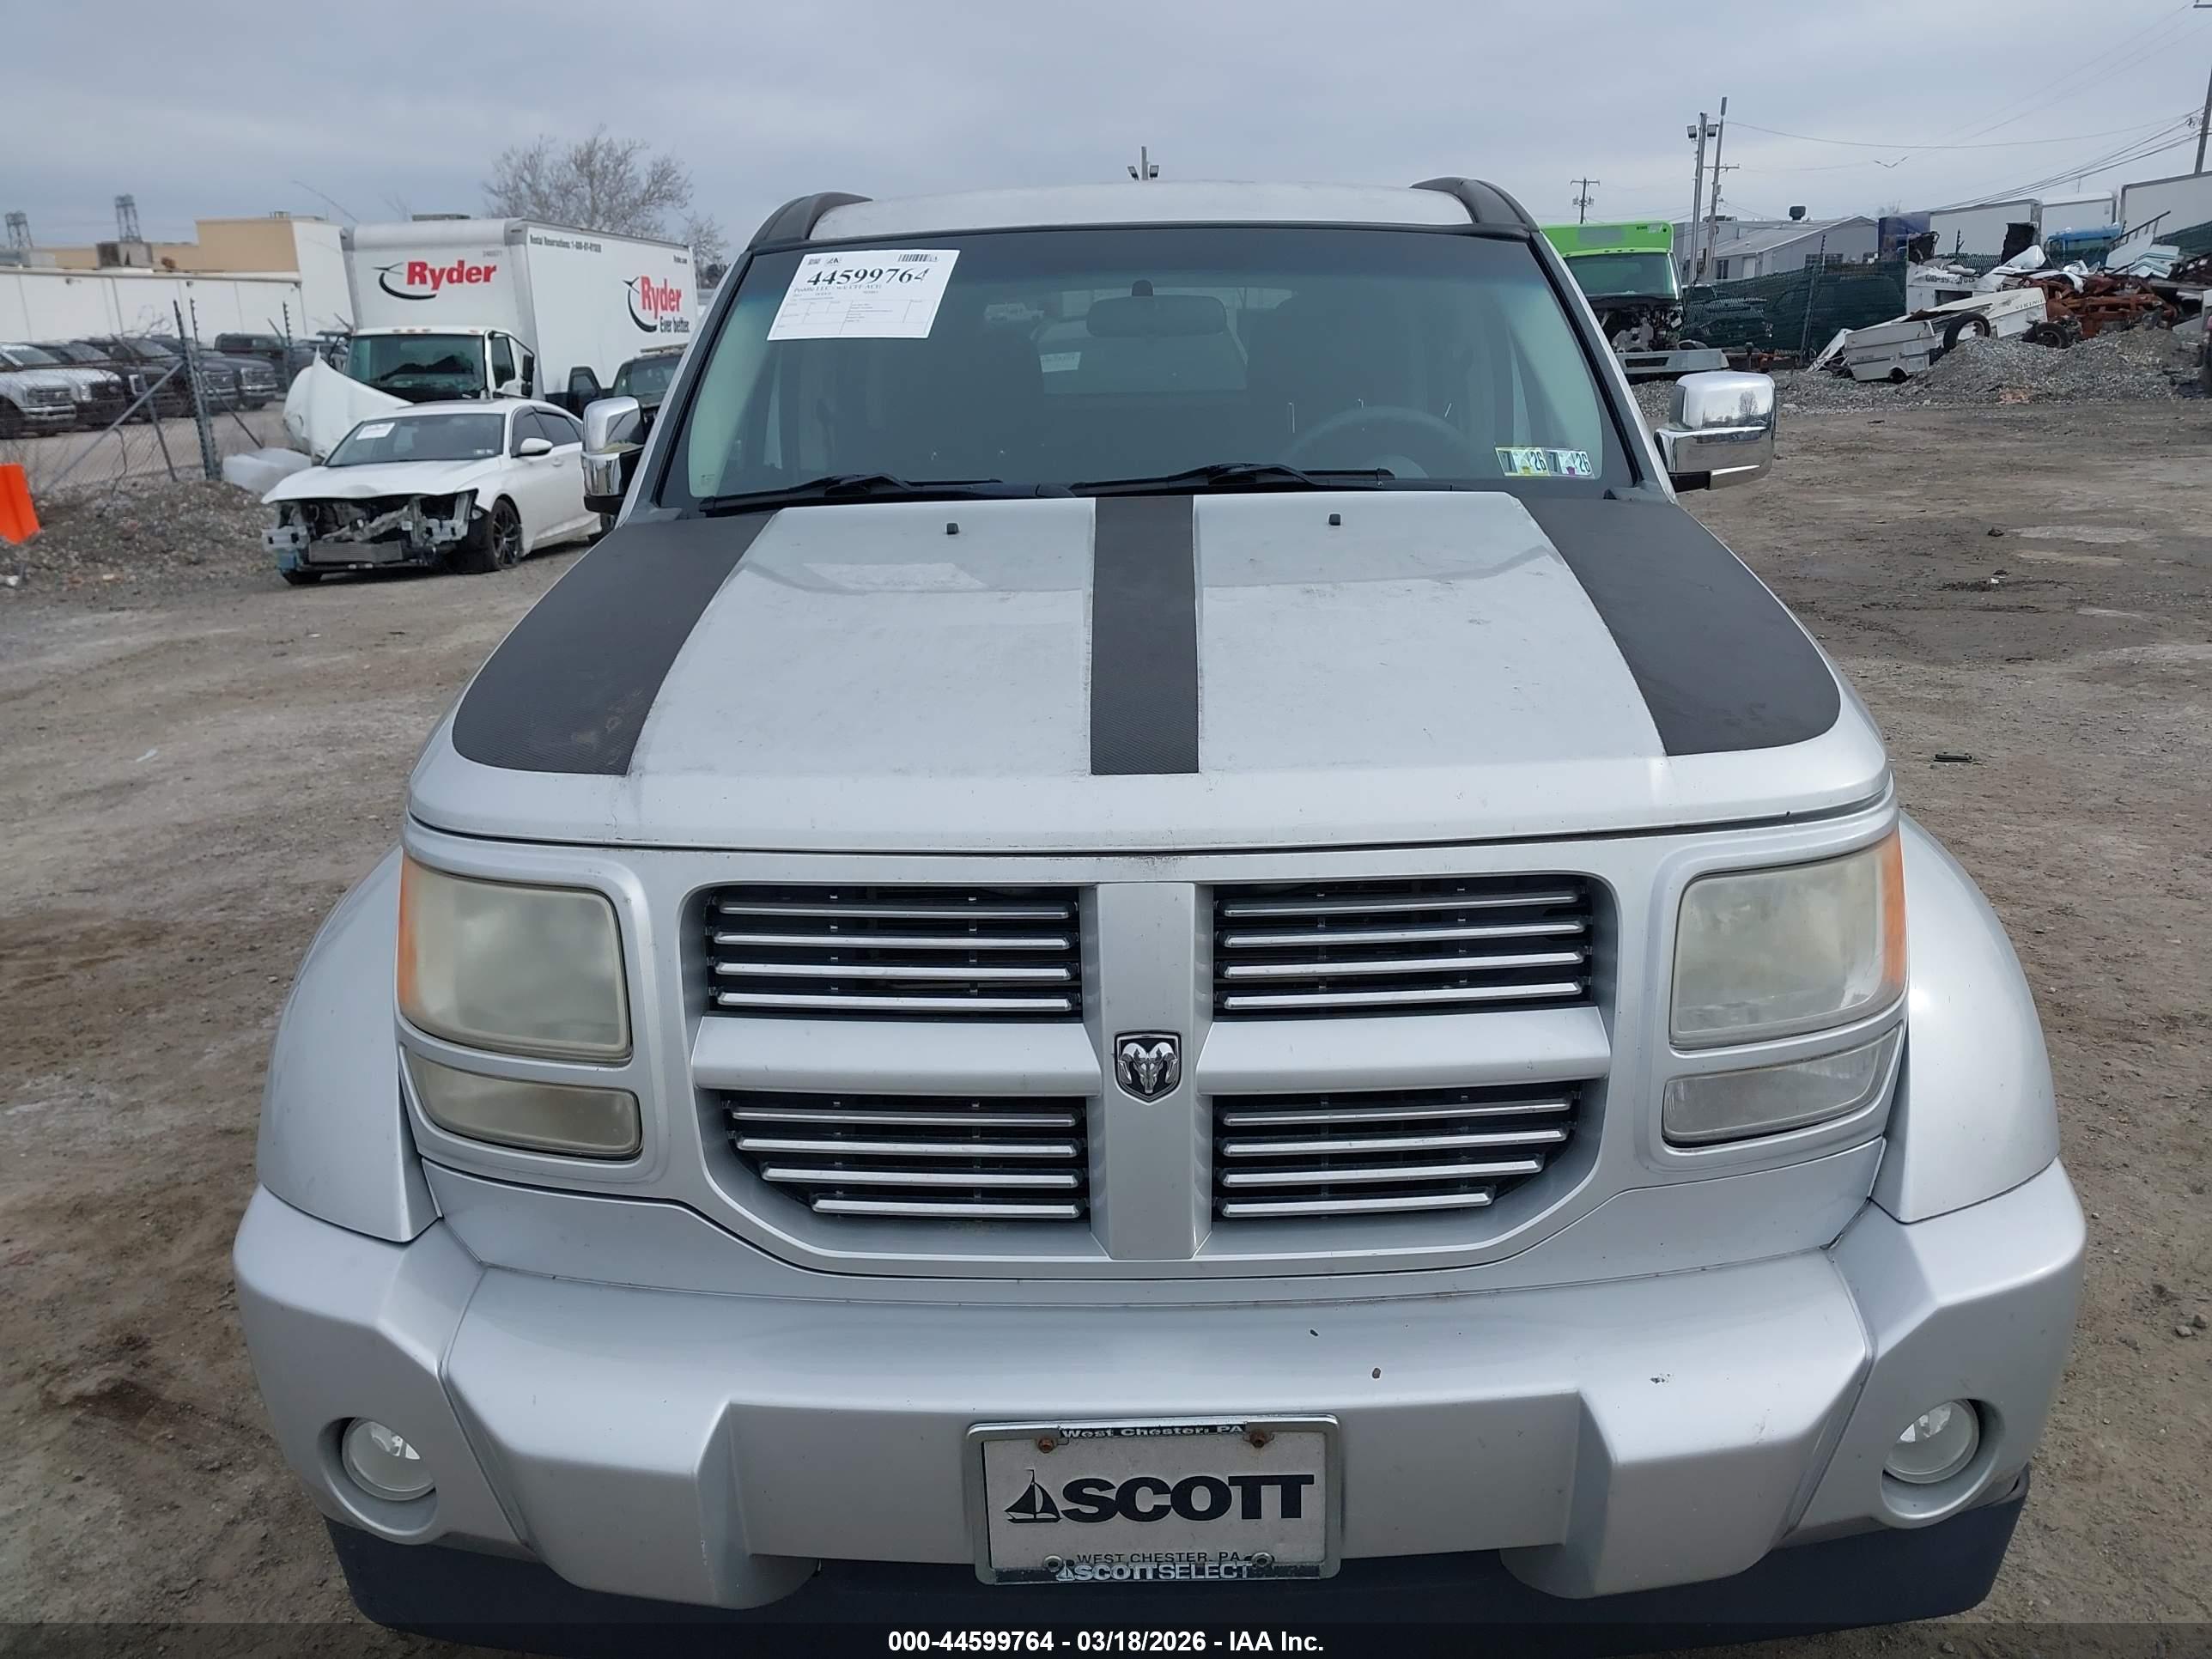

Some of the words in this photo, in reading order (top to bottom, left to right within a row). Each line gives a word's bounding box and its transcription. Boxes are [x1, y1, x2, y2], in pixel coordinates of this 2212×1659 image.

[407, 259, 497, 290] Ryder
[807, 268, 930, 286] 44599764
[641, 276, 682, 319] Ryder
[659, 316, 672, 332] Ever
[1062, 1429, 1114, 1438] West
[1217, 1425, 1244, 1433] PA
[1060, 1474, 1315, 1523] SCOTT
[1077, 1553, 1125, 1564] WEST
[1219, 1552, 1243, 1562] PA
